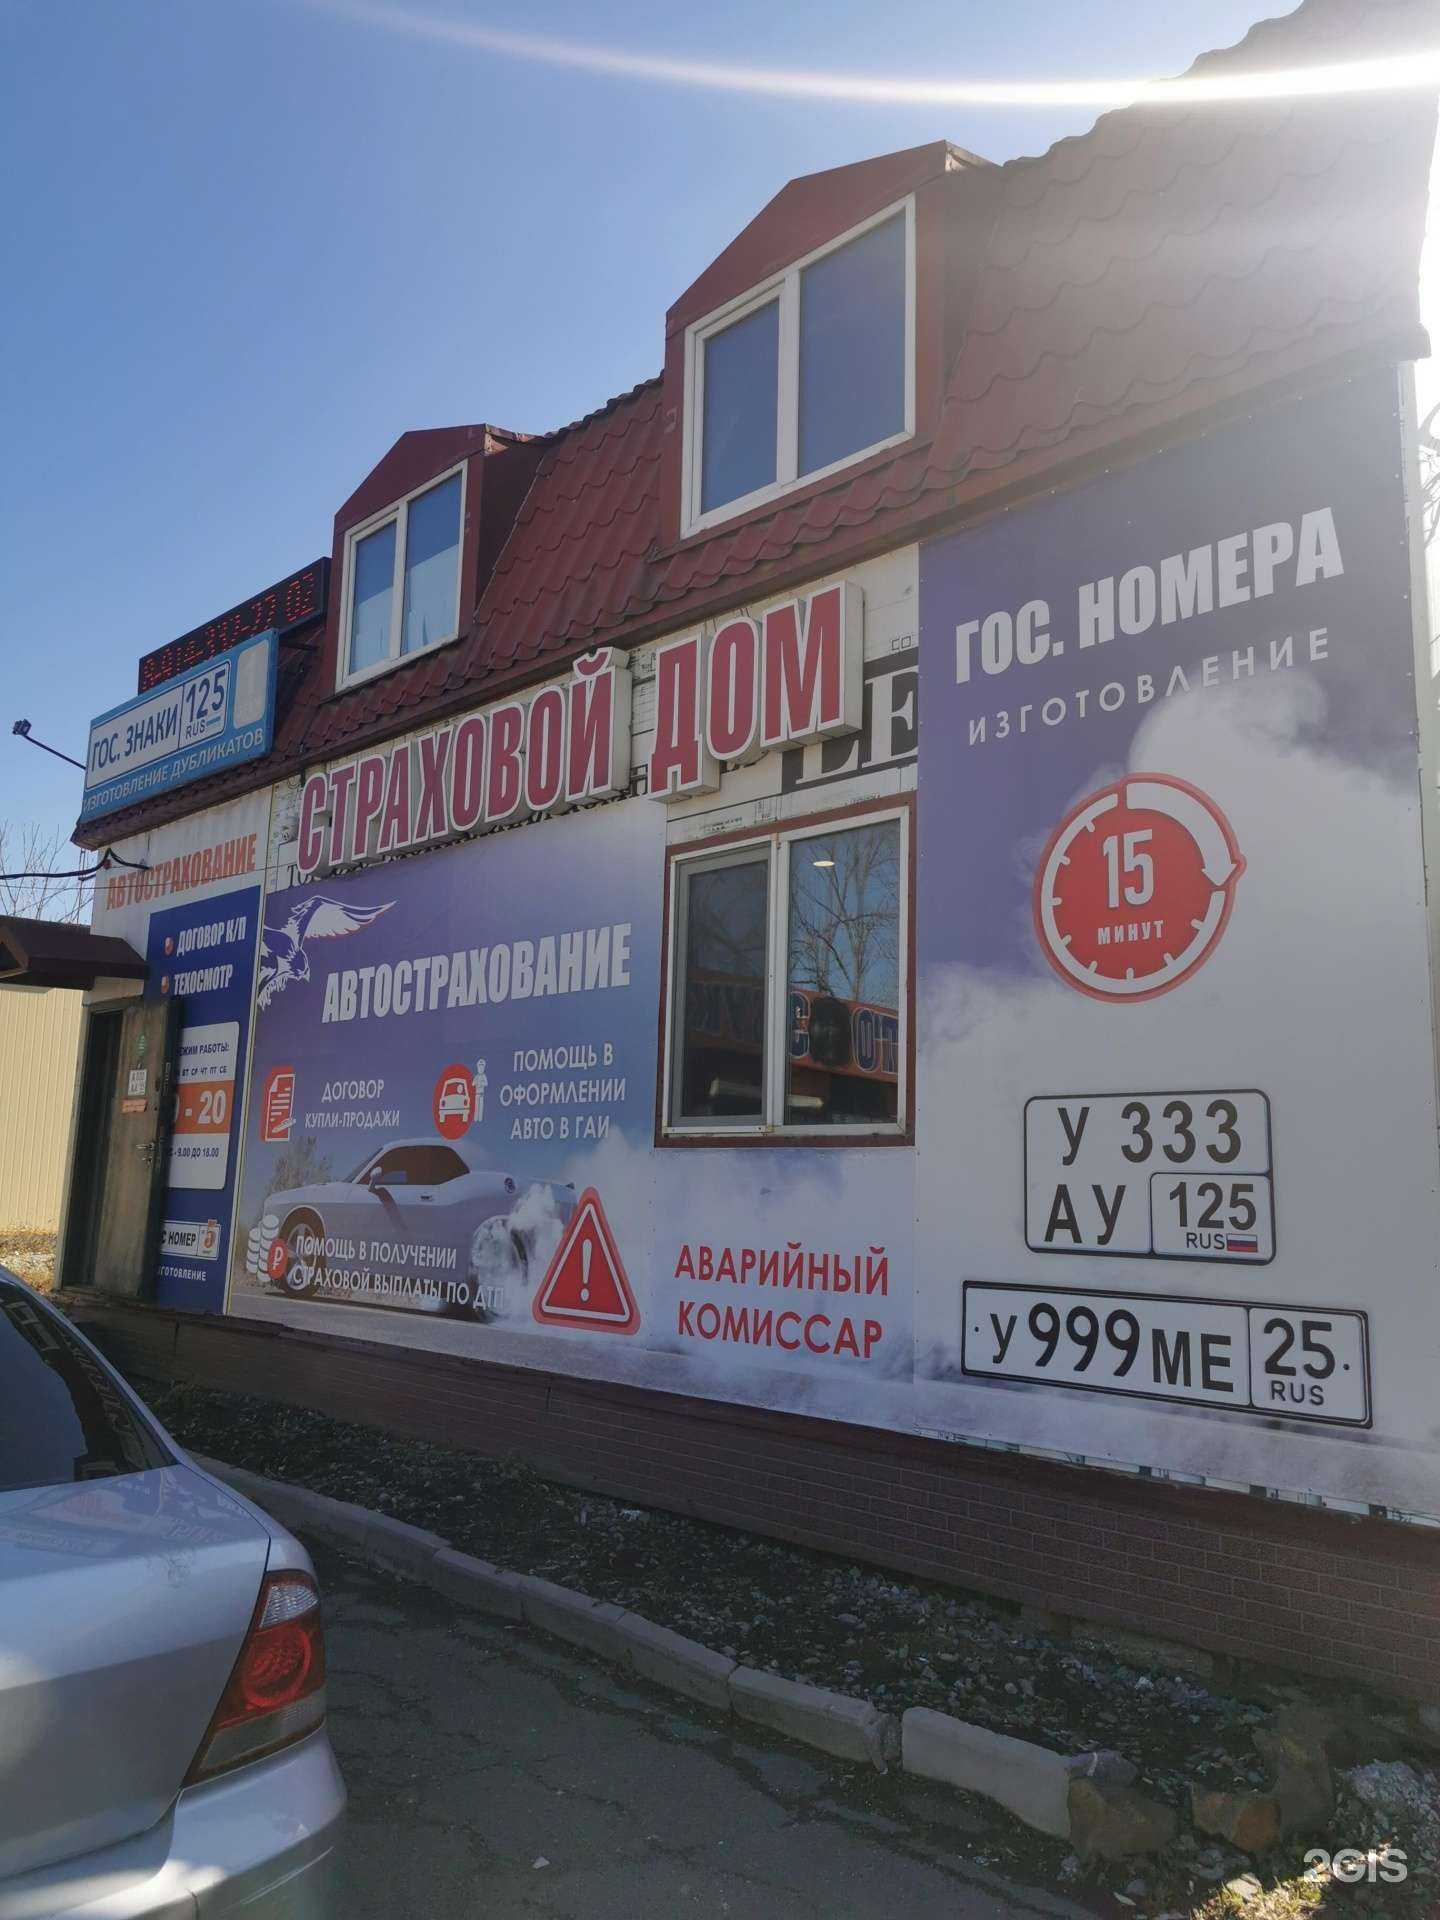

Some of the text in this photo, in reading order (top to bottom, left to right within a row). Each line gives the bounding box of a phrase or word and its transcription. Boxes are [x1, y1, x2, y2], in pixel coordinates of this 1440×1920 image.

[956, 506, 1344, 684] ГОС. НОМЕРА
[186, 669, 226, 723] 125
[968, 627, 1329, 746] ИЗГОТОВЛЕНИЕ
[91, 704, 179, 772] ГОС. ЗНАКИ
[185, 719, 206, 740] RUS
[297, 579, 850, 874] СТРАХОВОЙ ДОМ
[83, 728, 263, 813] ИЗГОТОВЛЕНИЕ ДУБЛИКАТОВ
[106, 833, 257, 910] АВТОСТРАХОВАНИЕ
[1103, 829, 1154, 908] 15
[176, 916, 247, 957] ДОГОВОР К/П
[1097, 919, 1165, 945] МИНУТ
[173, 964, 233, 996] ТЕХОСМОТР
[322, 923, 632, 1023] АВТОСТРАХОВАНИЕ
[177, 1045, 198, 1057] ЕЖИМ
[513, 1042, 613, 1073] ПОМОЩЬ В
[198, 1089, 226, 1124] 20
[321, 1079, 384, 1103] ДОГОВОР
[500, 1078, 626, 1107] ОФОРМЛЕНИИ
[305, 1109, 400, 1129] КУПЛИ-ПРОДАЖИ
[510, 1115, 609, 1140] АВТО В ГАИ
[1057, 1099, 1241, 1166] У 333
[1044, 1184, 1127, 1246] АУ
[1169, 1181, 1257, 1231] 125
[168, 1231, 197, 1247] НОМЕР
[296, 1236, 457, 1269] ПОМОЩЬ В ПОЛУЧЕНИИ
[1186, 1231, 1225, 1251] RUS
[293, 1266, 504, 1310] СТРАХОВОЙ ВЫПЛАТЫ ПО ДТП
[675, 1241, 888, 1296] АВАРИЙНЫЙ
[677, 1300, 882, 1359] КОМИССАР
[990, 1302, 1234, 1393] У999МЕ
[1263, 1318, 1335, 1379] 25
[1270, 1380, 1324, 1406] RUS
